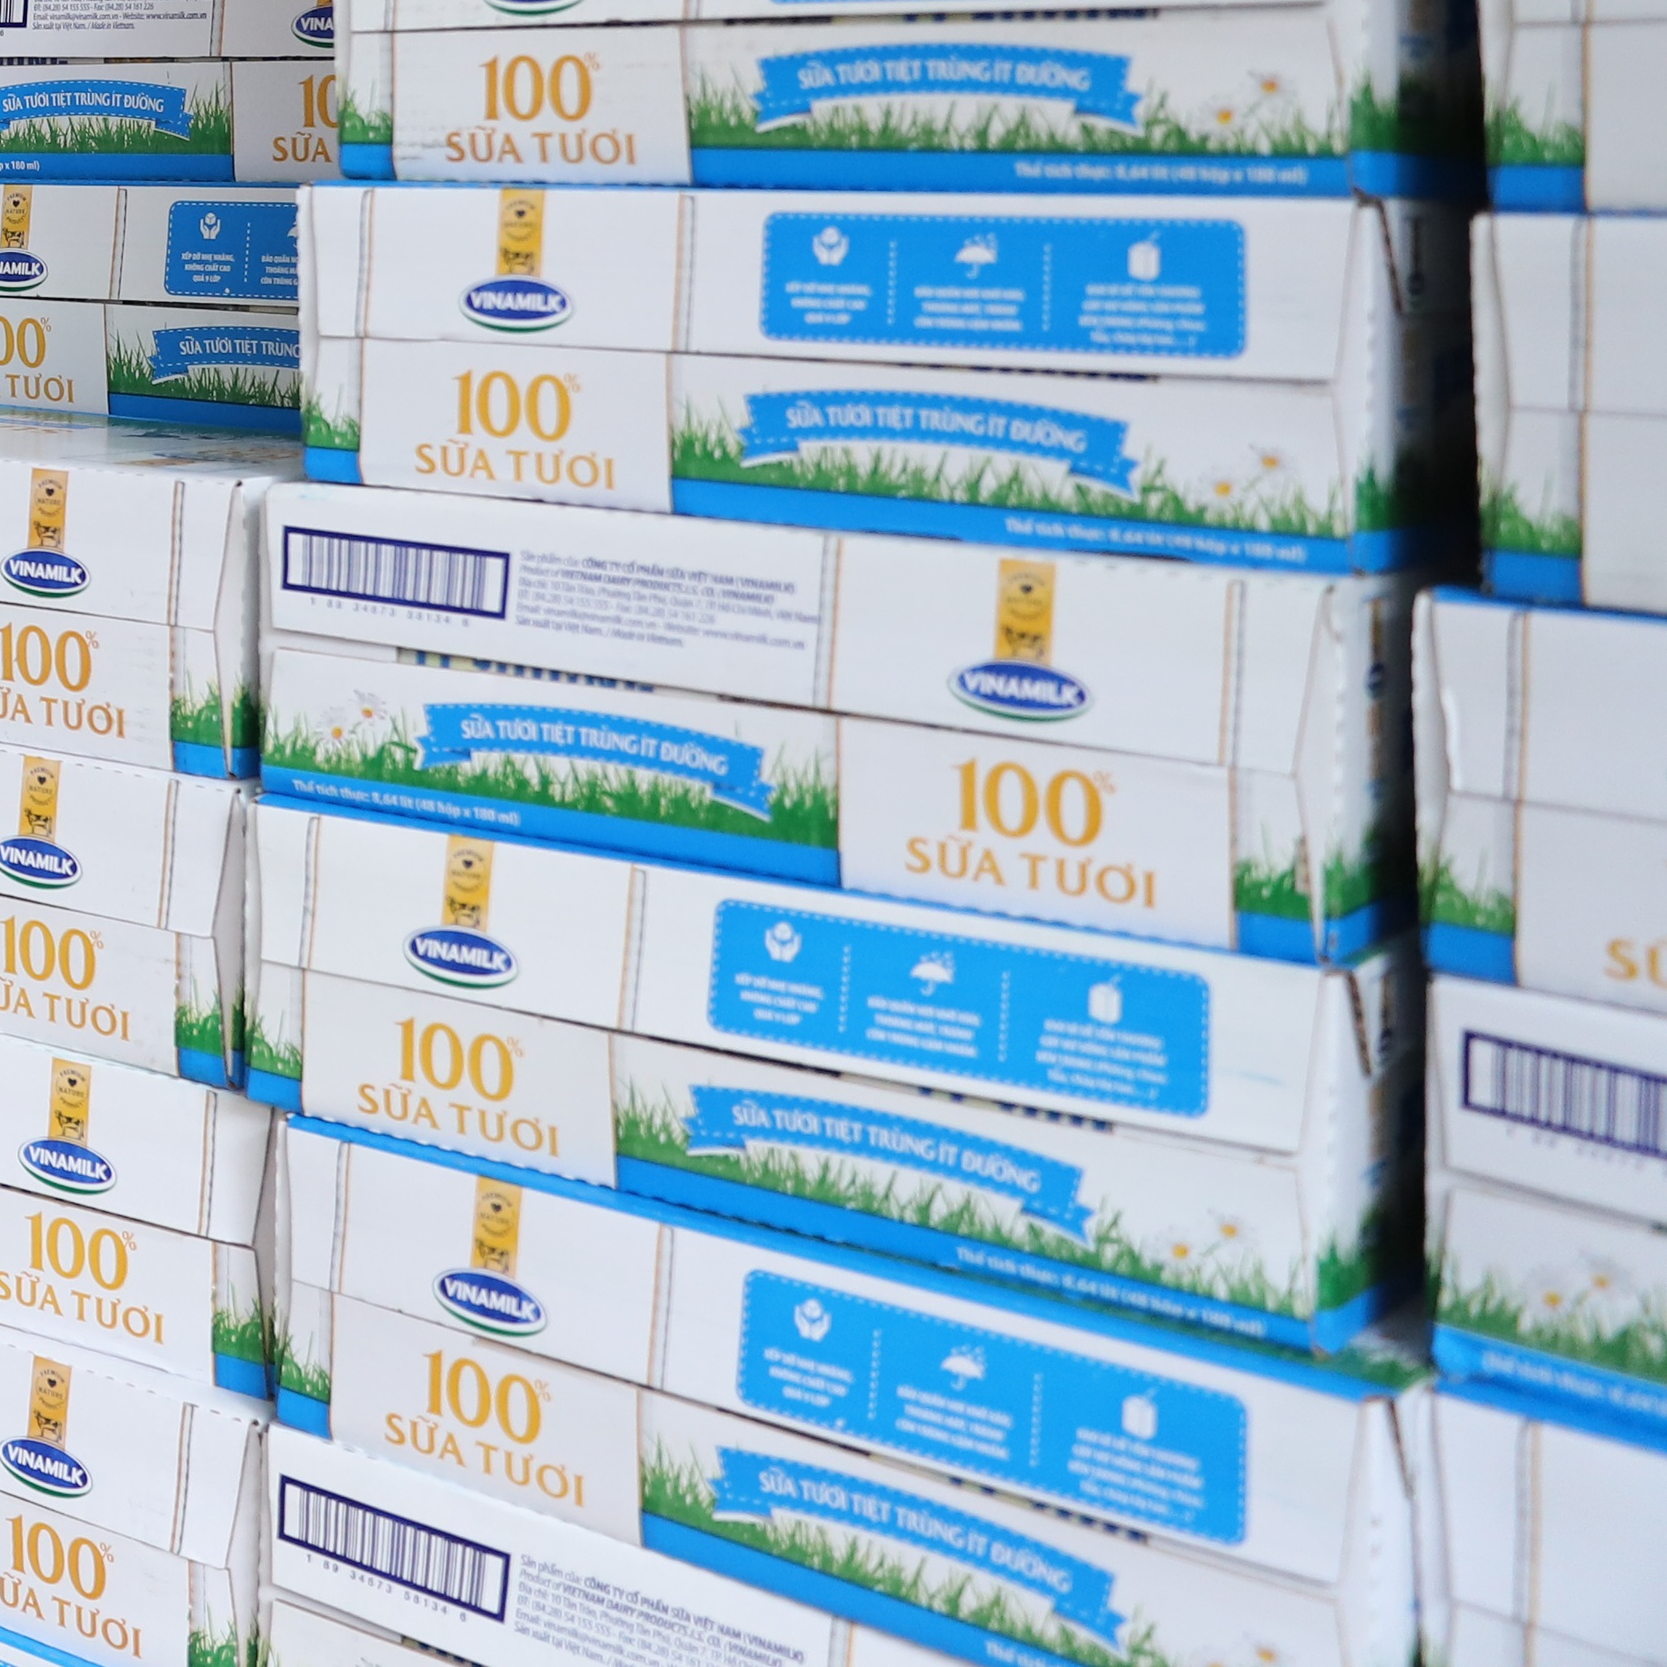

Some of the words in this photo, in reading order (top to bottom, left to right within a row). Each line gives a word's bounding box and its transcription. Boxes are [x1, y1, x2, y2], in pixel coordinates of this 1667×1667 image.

[468, 289, 564, 316] VINAMILK
[8, 559, 82, 586] VINAMILK
[962, 671, 1080, 707] VINAMILK
[42, 698, 127, 740] TƯƠI
[28, 1145, 108, 1182] VINAMILK
[70, 1291, 164, 1346] TƯƠI
